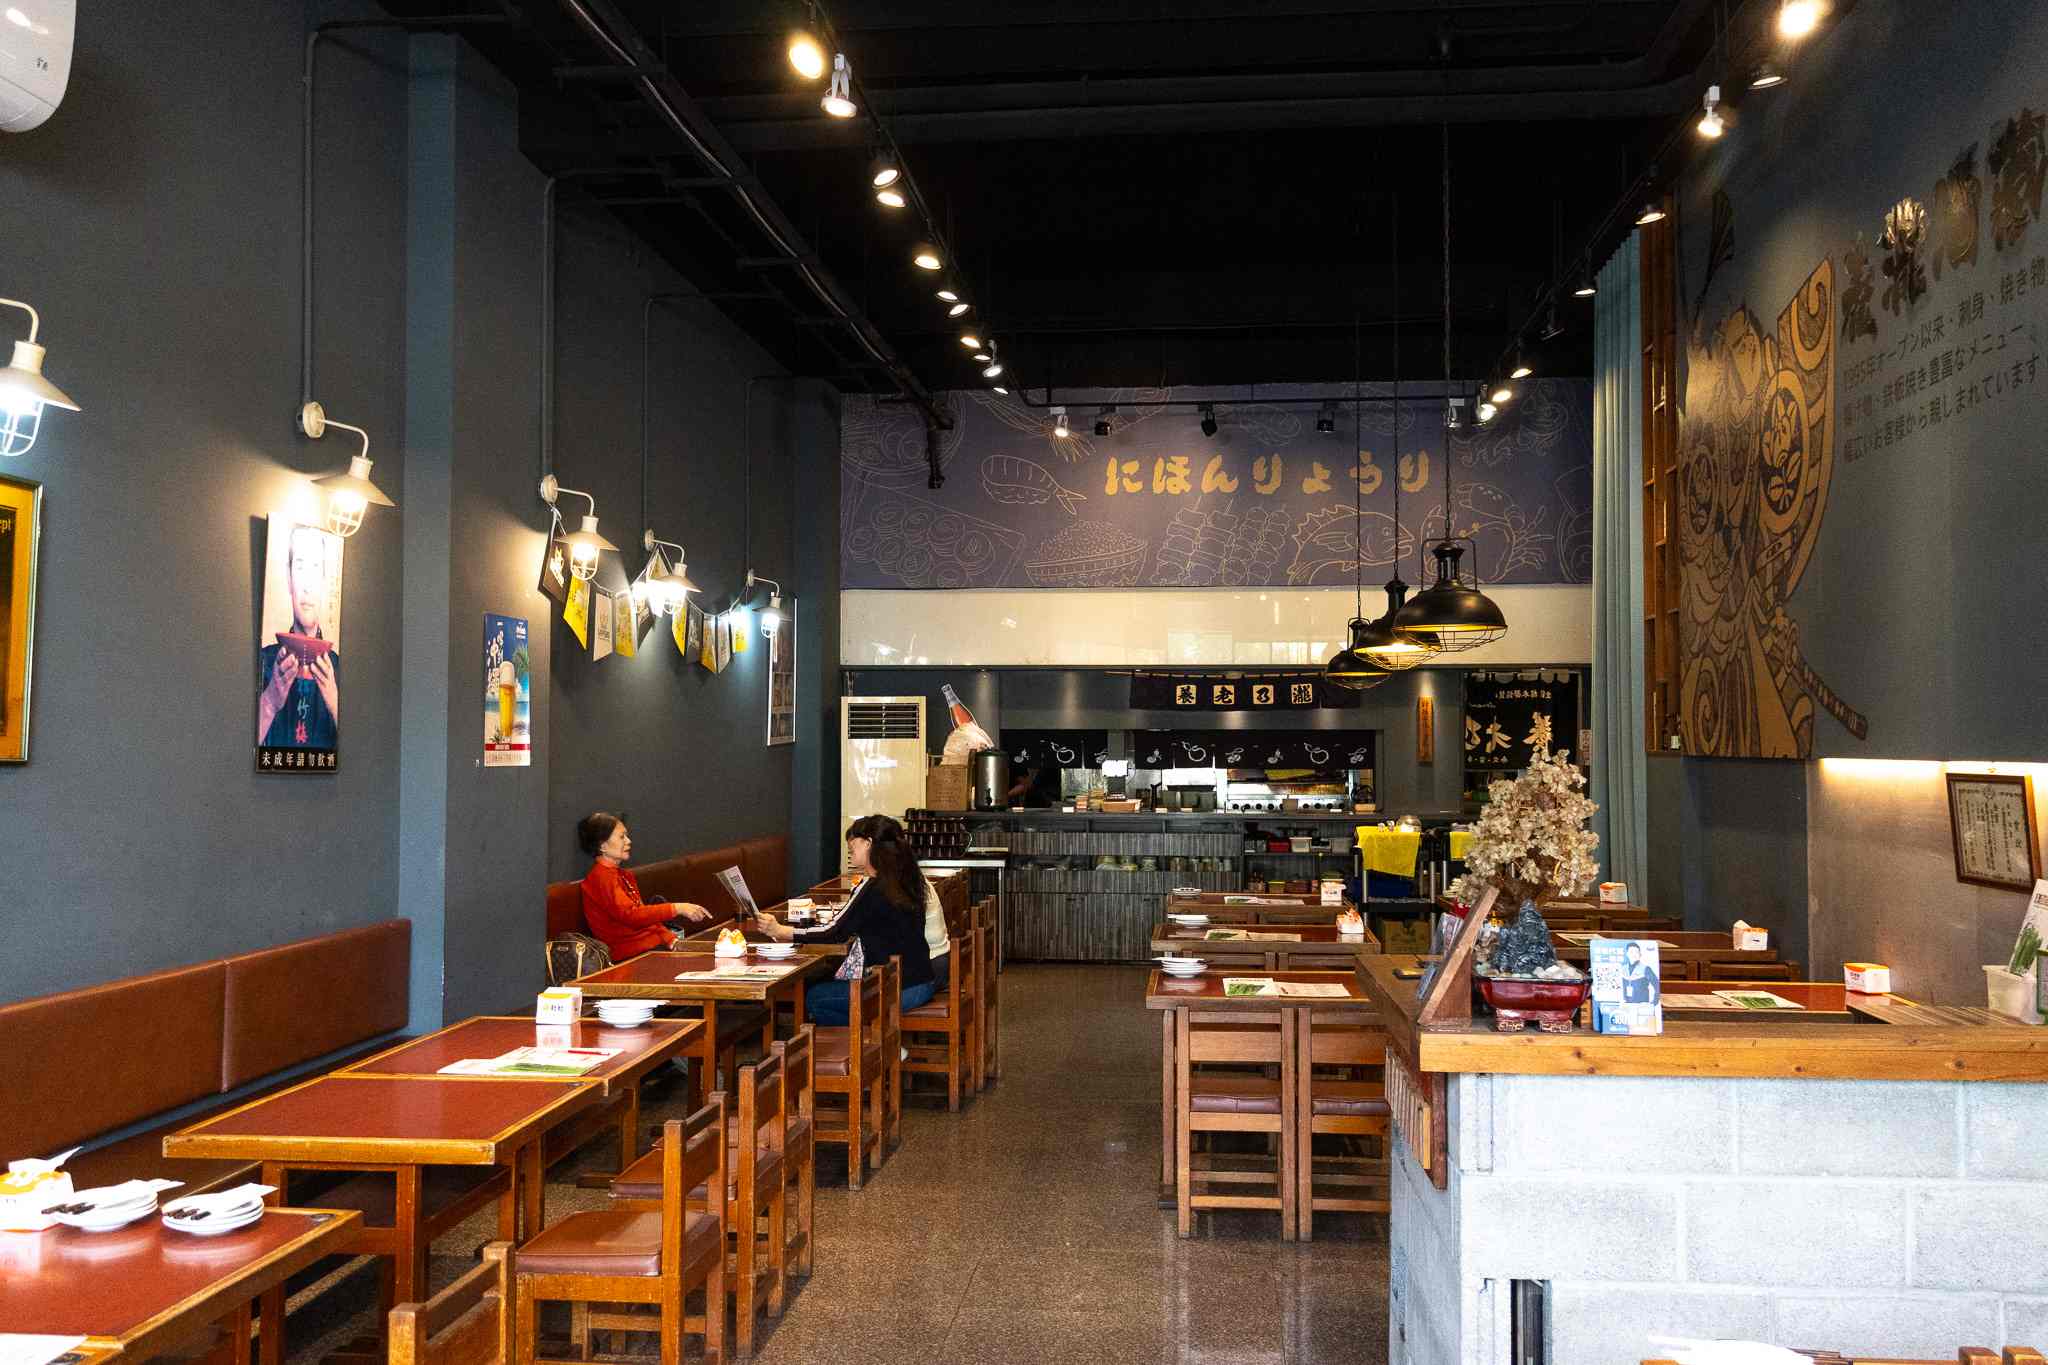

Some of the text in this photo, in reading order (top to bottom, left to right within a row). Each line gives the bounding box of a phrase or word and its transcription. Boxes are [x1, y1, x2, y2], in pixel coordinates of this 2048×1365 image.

[1105, 451, 1429, 495] にほんりょうり
[1177, 684, 1313, 704] 養老乃瀧
[262, 751, 336, 767] 未成年請勿飲酒
